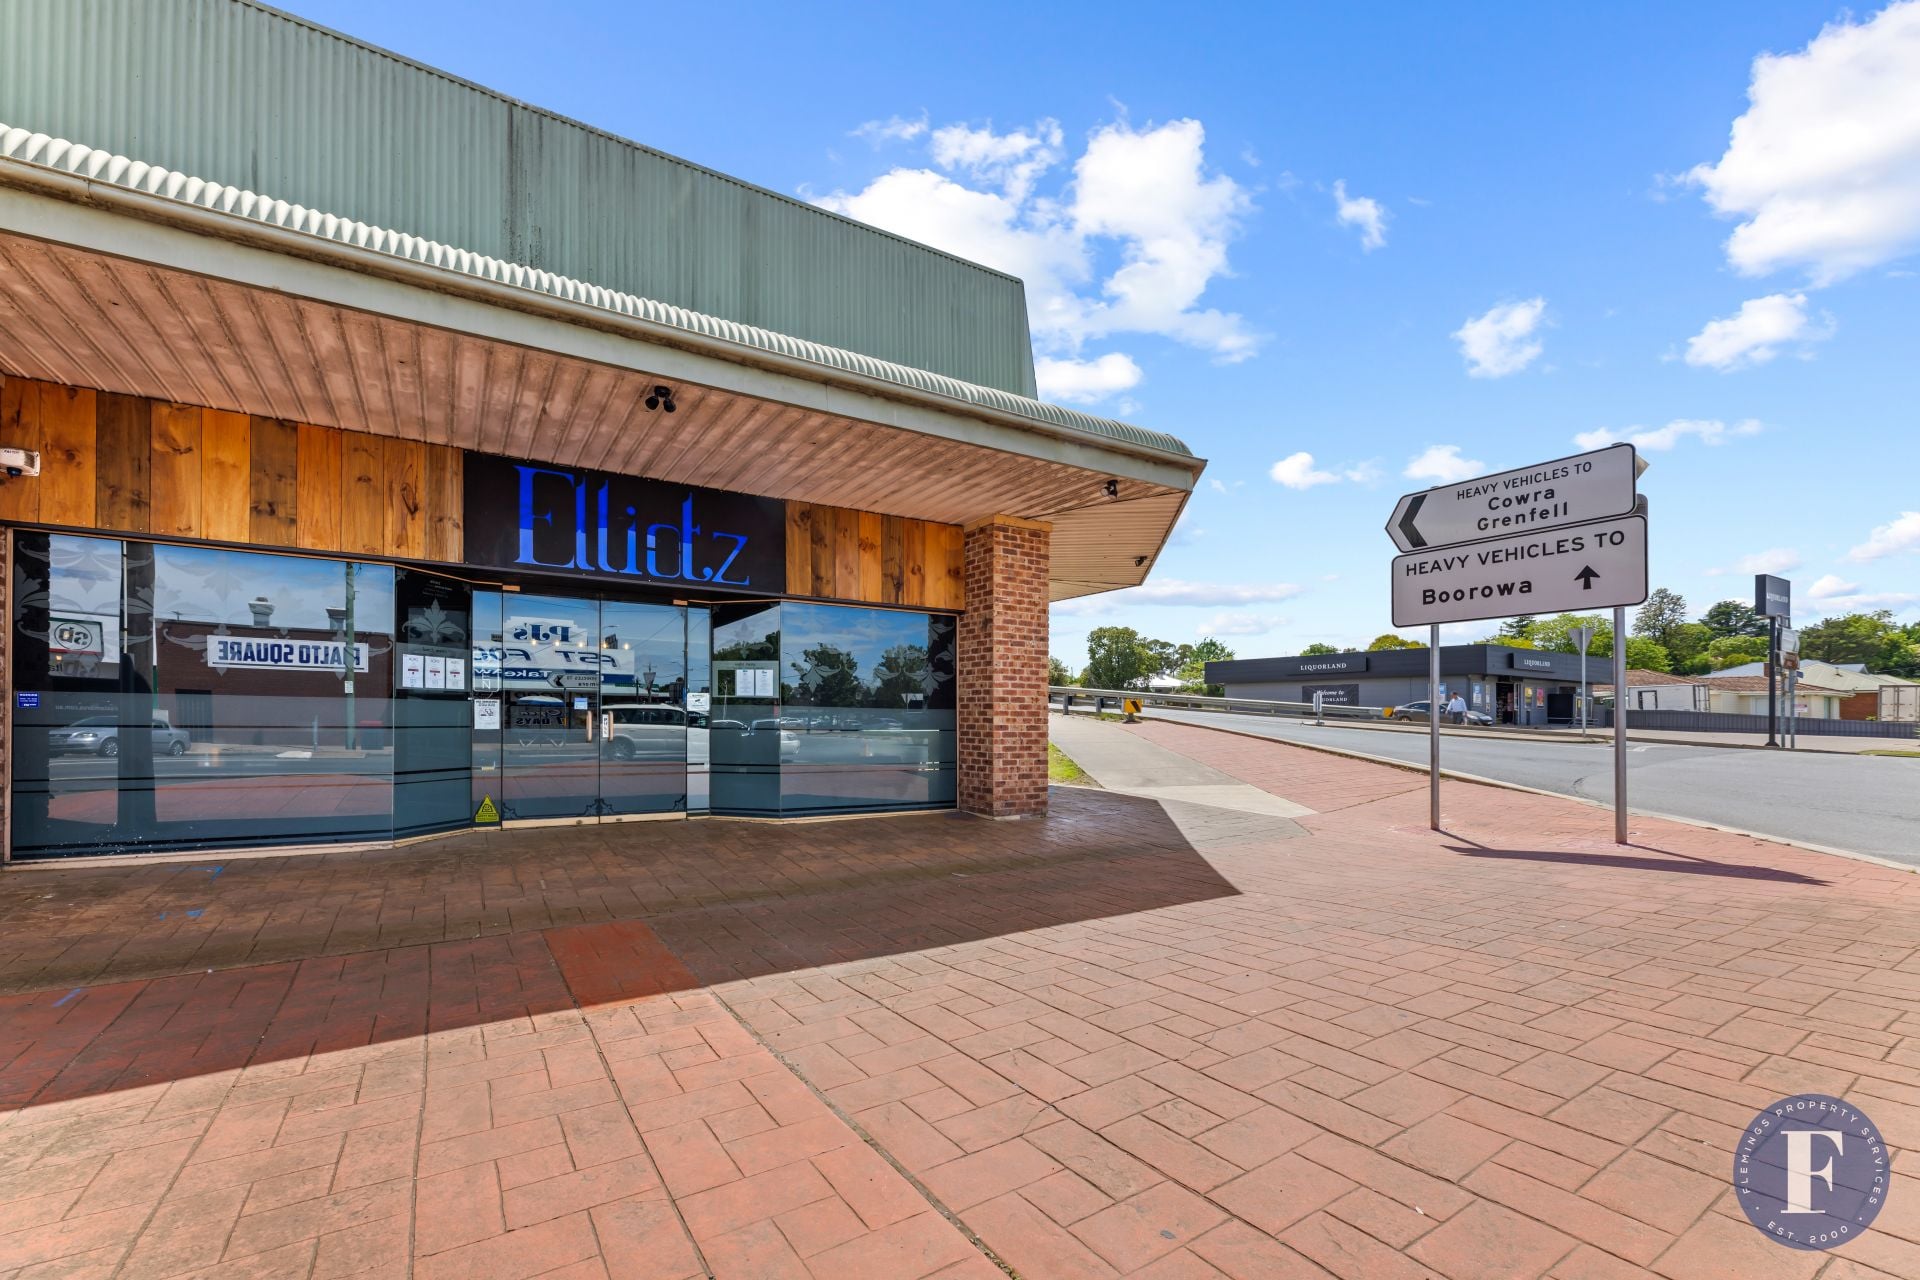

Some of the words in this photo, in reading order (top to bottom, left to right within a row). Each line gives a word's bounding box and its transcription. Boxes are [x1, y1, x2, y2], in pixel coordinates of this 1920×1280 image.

[1456, 481, 1499, 501] HEAVY
[1503, 466, 1570, 490] VEHICLES
[1573, 461, 1593, 475] TO
[1487, 487, 1555, 511] Cowra
[513, 464, 750, 586] Elliotz
[1476, 502, 1569, 531] Grenfell
[1405, 554, 1470, 577] HEAVY
[1477, 536, 1586, 566] VEHICLES
[1594, 530, 1625, 548] TO
[1422, 580, 1533, 606] Boorowa
[1300, 662, 1347, 672] LIQUORLAND
